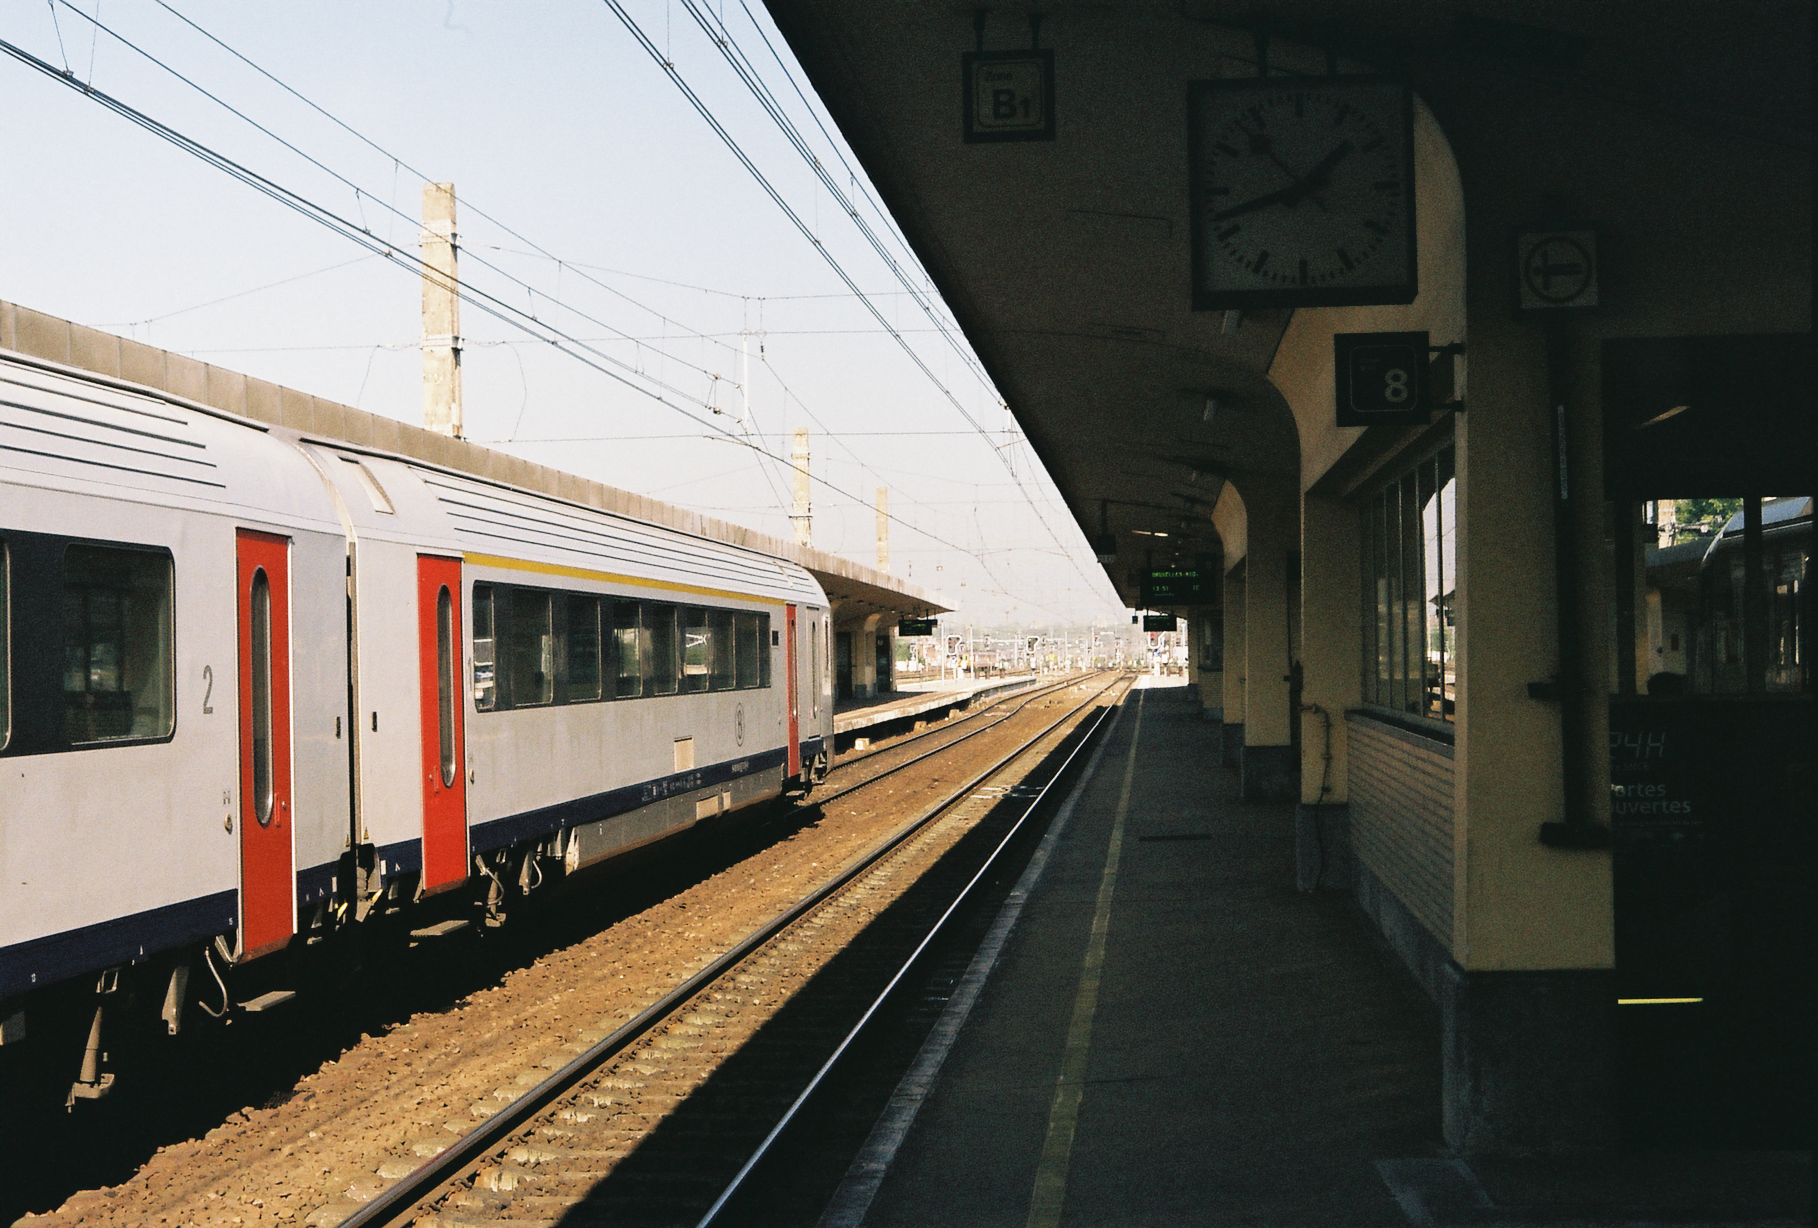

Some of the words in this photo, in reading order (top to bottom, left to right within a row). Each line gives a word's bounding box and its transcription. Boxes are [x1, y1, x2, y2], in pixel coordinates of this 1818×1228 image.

[1384, 368, 1408, 403] 8
[203, 665, 213, 714] 2
[1612, 783, 1666, 798] ortes
[1611, 799, 1691, 815] uvertes
